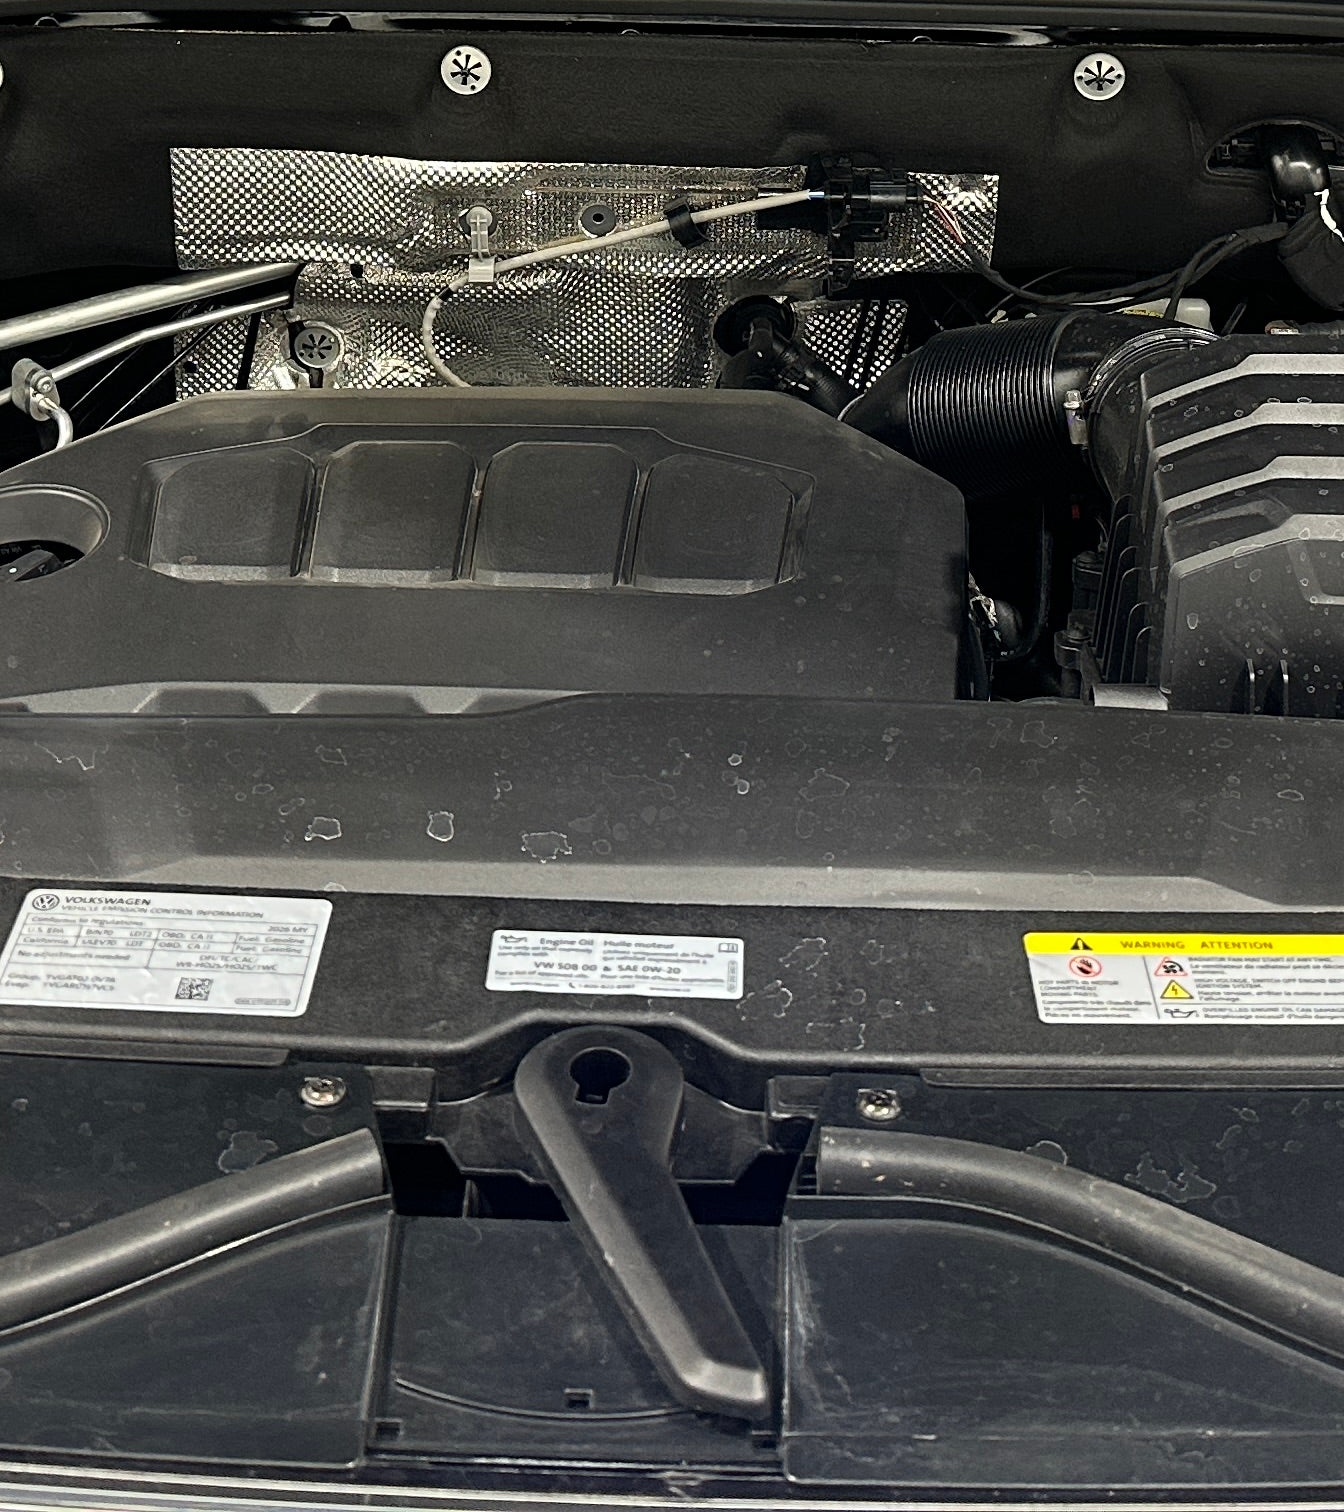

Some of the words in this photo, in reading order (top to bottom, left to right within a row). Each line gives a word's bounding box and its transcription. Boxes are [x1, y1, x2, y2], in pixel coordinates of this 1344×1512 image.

[64, 896, 152, 906] VOLKSWAGEN
[197, 910, 263, 919] INFORMATION
[539, 938, 577, 946] Engine
[578, 938, 594, 946] Oil
[1120, 941, 1186, 949] WARNING
[1200, 941, 1273, 949] ATTENTION
[557, 962, 578, 971] 508
[617, 964, 639, 972] SAE
